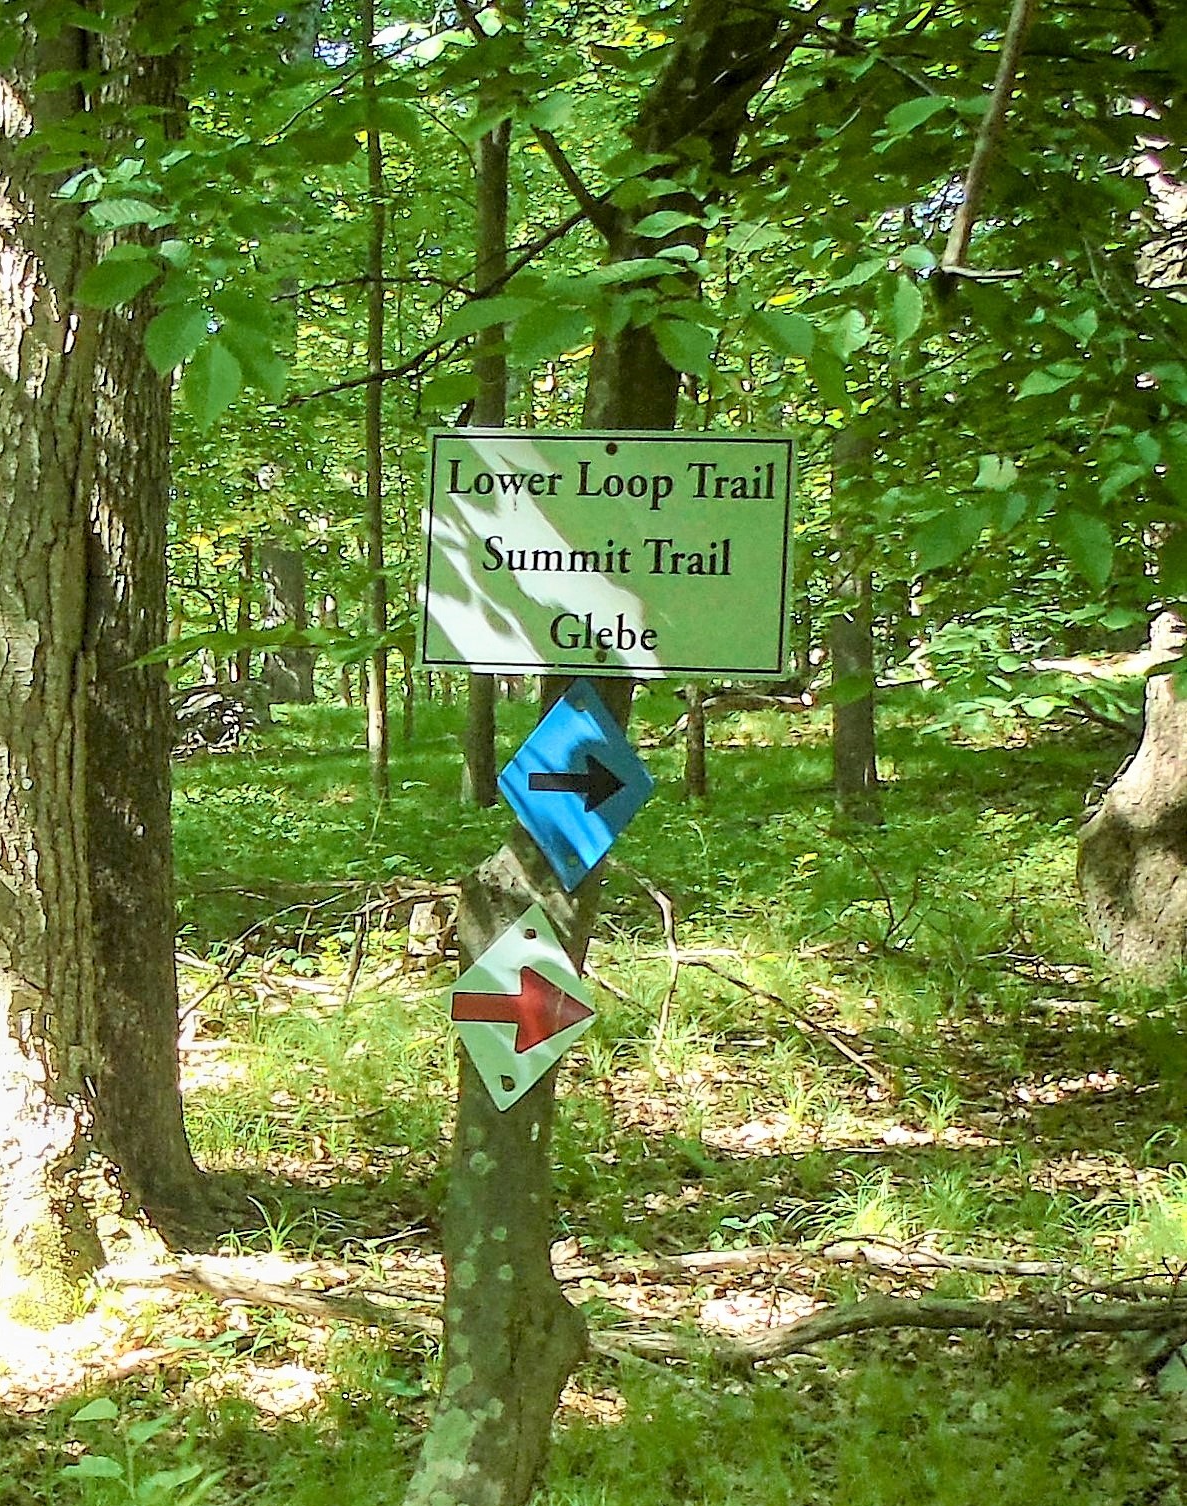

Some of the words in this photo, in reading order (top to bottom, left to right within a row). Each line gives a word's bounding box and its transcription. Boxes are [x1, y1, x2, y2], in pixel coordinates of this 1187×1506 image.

[447, 459, 562, 496] Lower
[577, 461, 674, 510] Loop
[687, 462, 775, 499] Trail
[482, 535, 631, 574] Summit
[643, 538, 732, 576] Trail
[550, 613, 658, 651] Glebe
